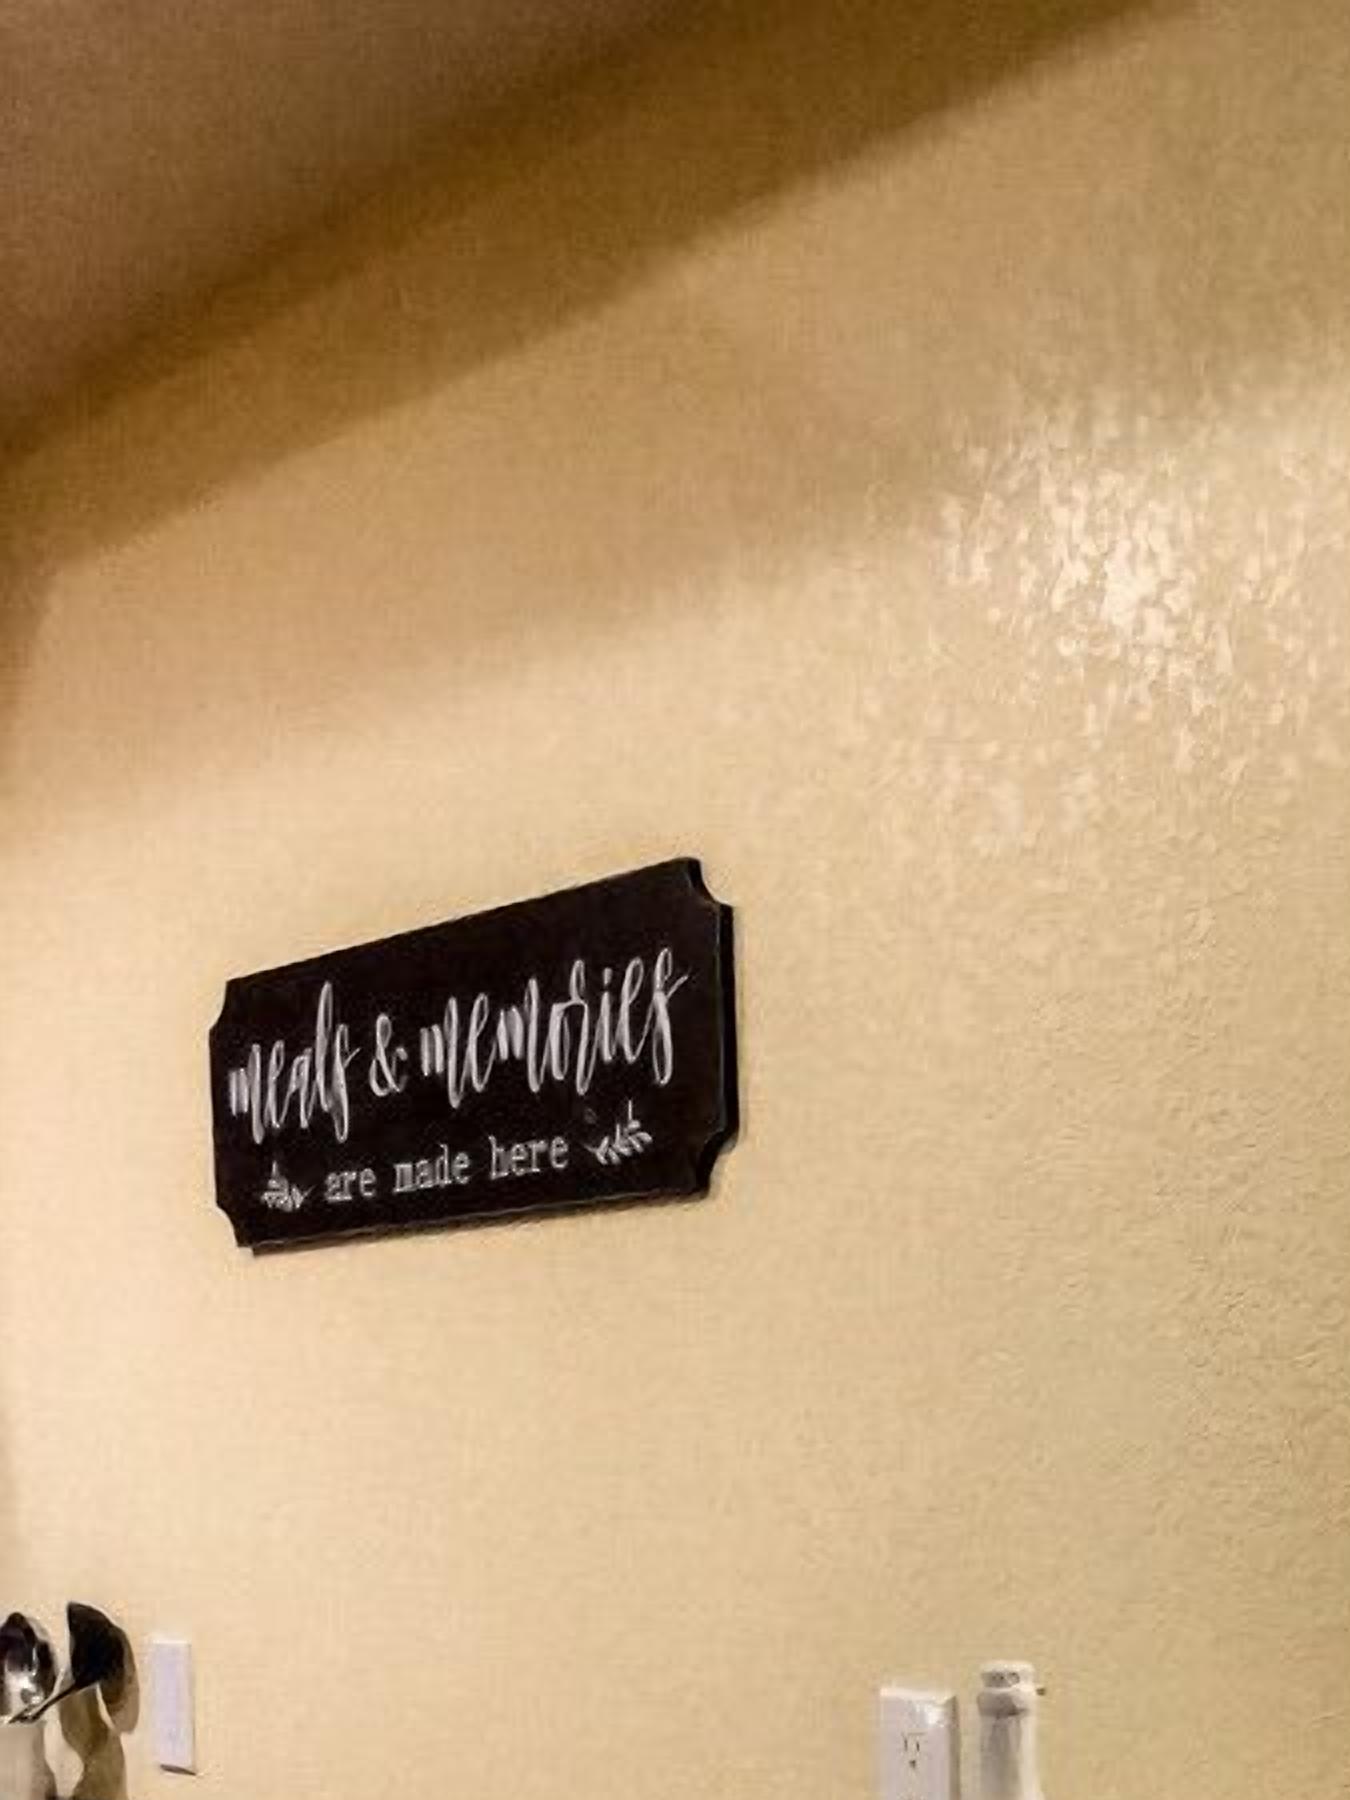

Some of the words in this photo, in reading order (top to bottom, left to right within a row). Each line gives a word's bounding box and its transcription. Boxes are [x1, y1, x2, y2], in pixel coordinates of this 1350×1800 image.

[228, 980, 361, 1143] meals
[369, 1013, 410, 1097] &
[419, 947, 690, 1108] memories
[323, 1166, 377, 1202] are
[393, 1143, 469, 1194] made
[487, 1134, 570, 1182] here
